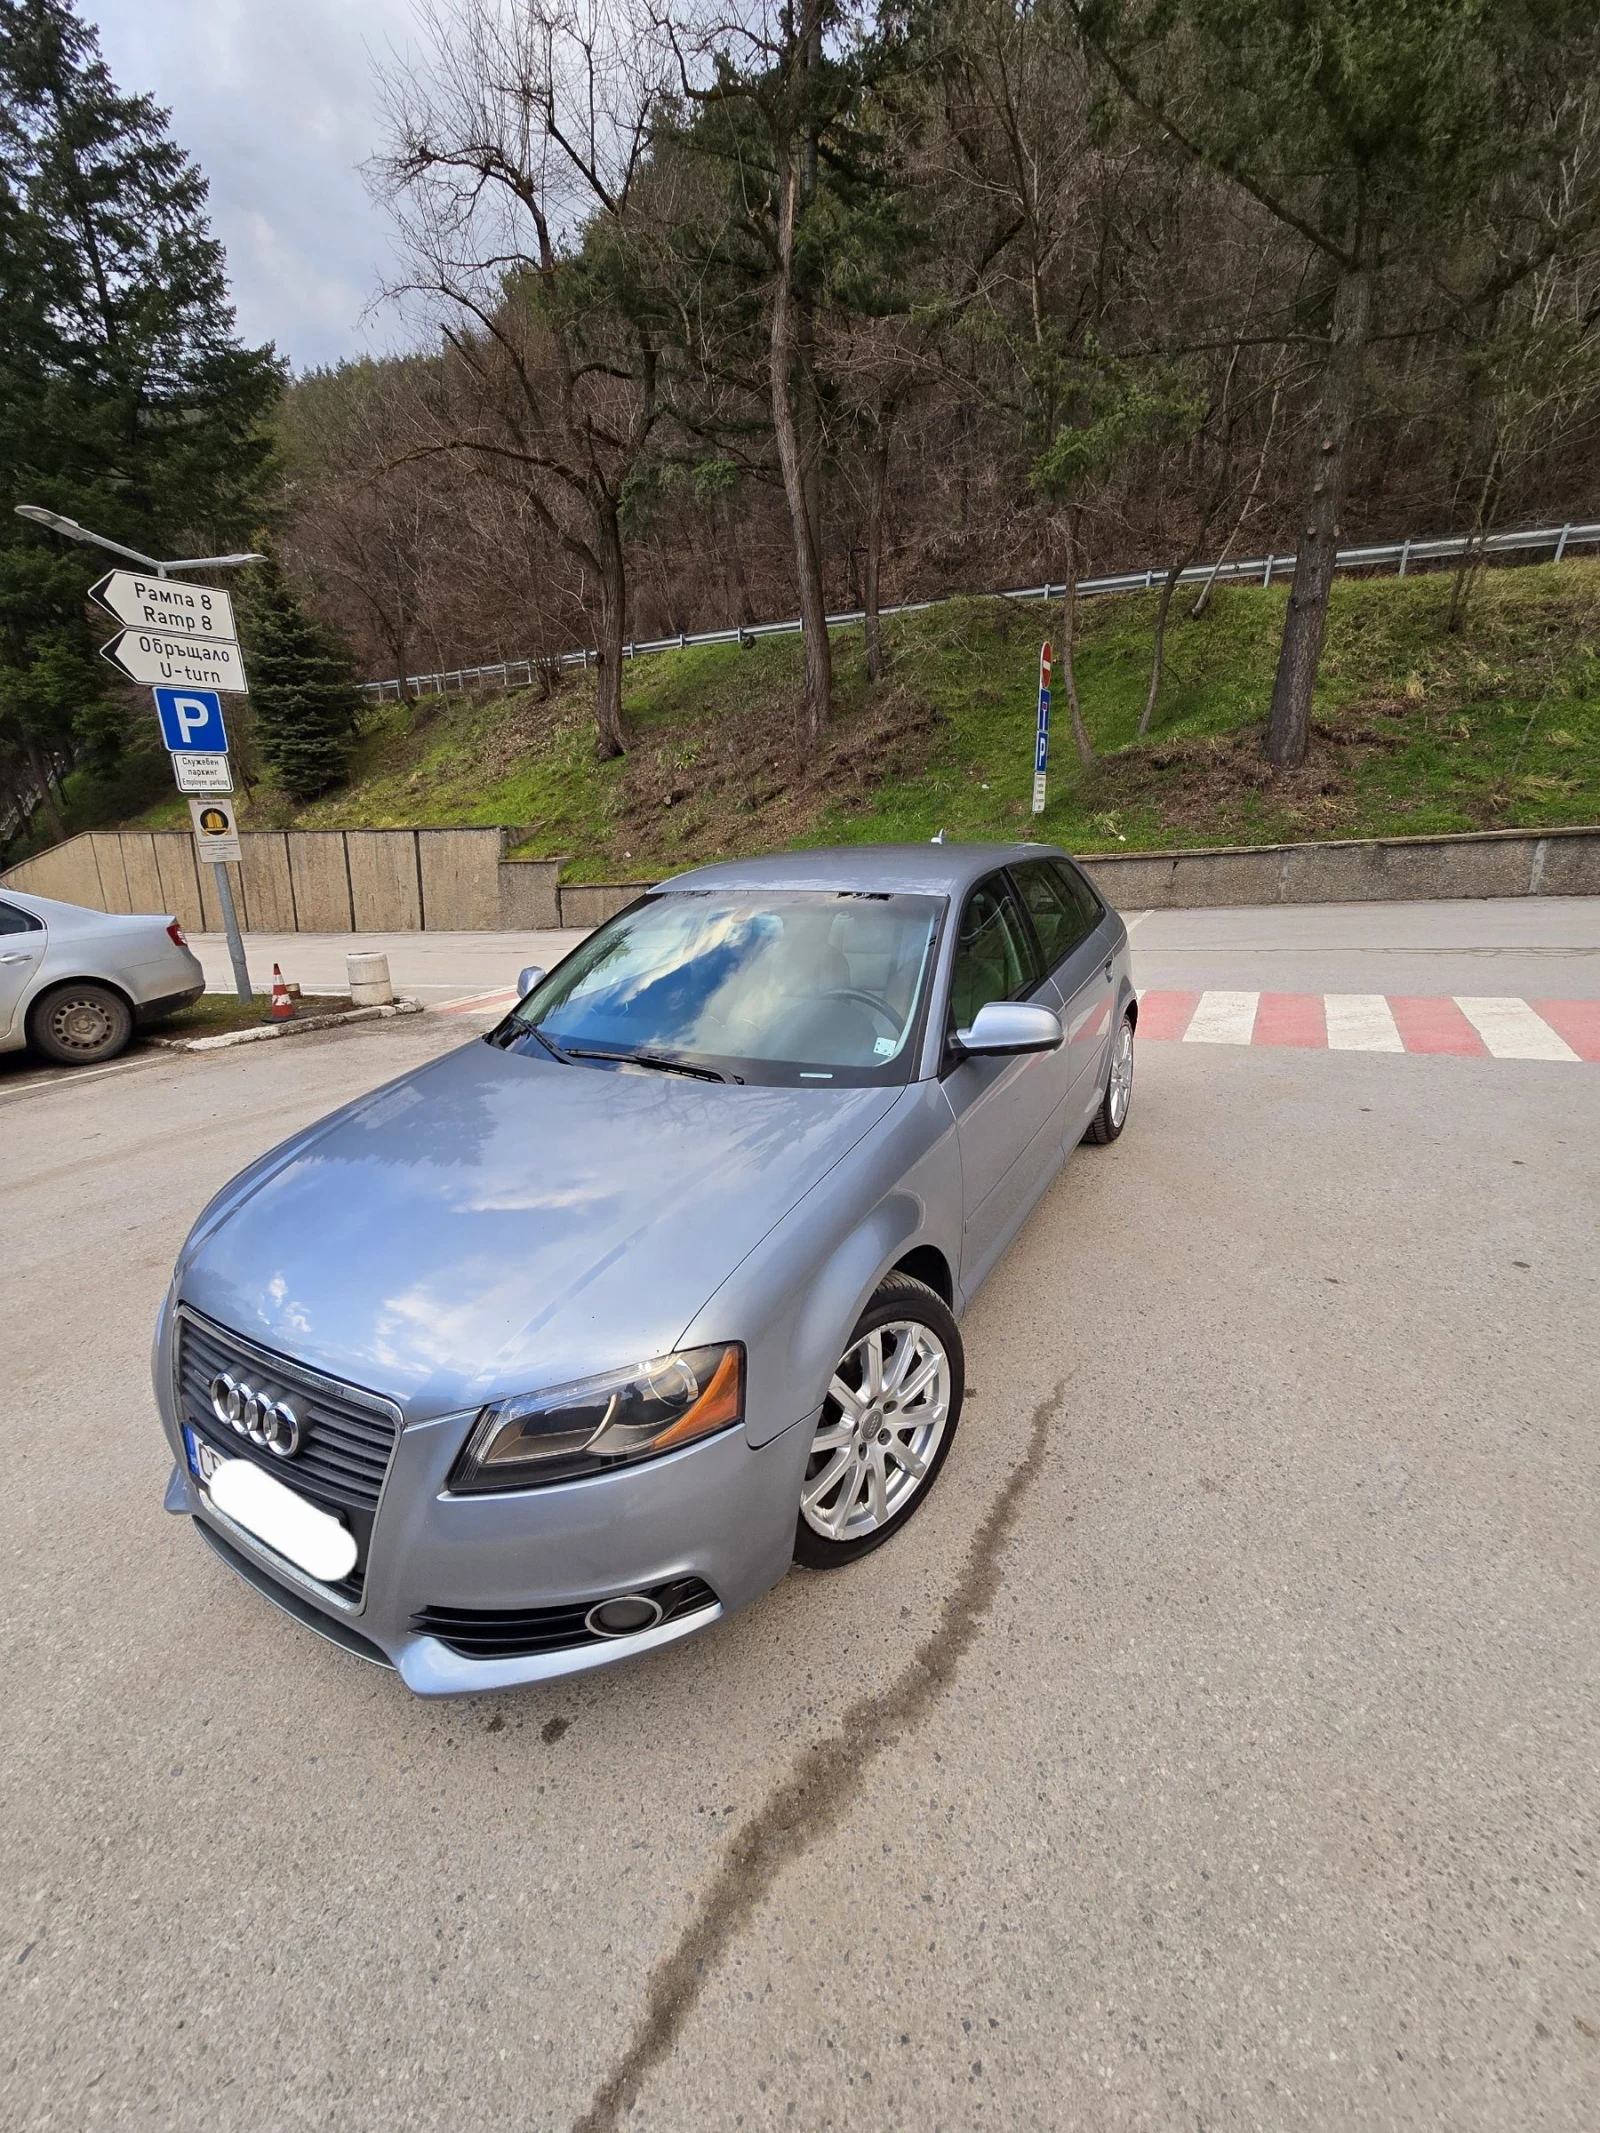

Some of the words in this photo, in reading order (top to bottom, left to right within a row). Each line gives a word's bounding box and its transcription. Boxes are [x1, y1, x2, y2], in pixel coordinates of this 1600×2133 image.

[134, 582, 195, 607] Рампа
[201, 594, 212, 610] 8
[143, 605, 195, 631] Ramp
[201, 615, 213, 630] 8
[139, 636, 230, 662] Обръщало
[160, 662, 221, 682] U-turn
[173, 697, 209, 743] P
[182, 757, 219, 767] Служебен
[1039, 737, 1046, 767] P
[182, 778, 208, 787] Employee
